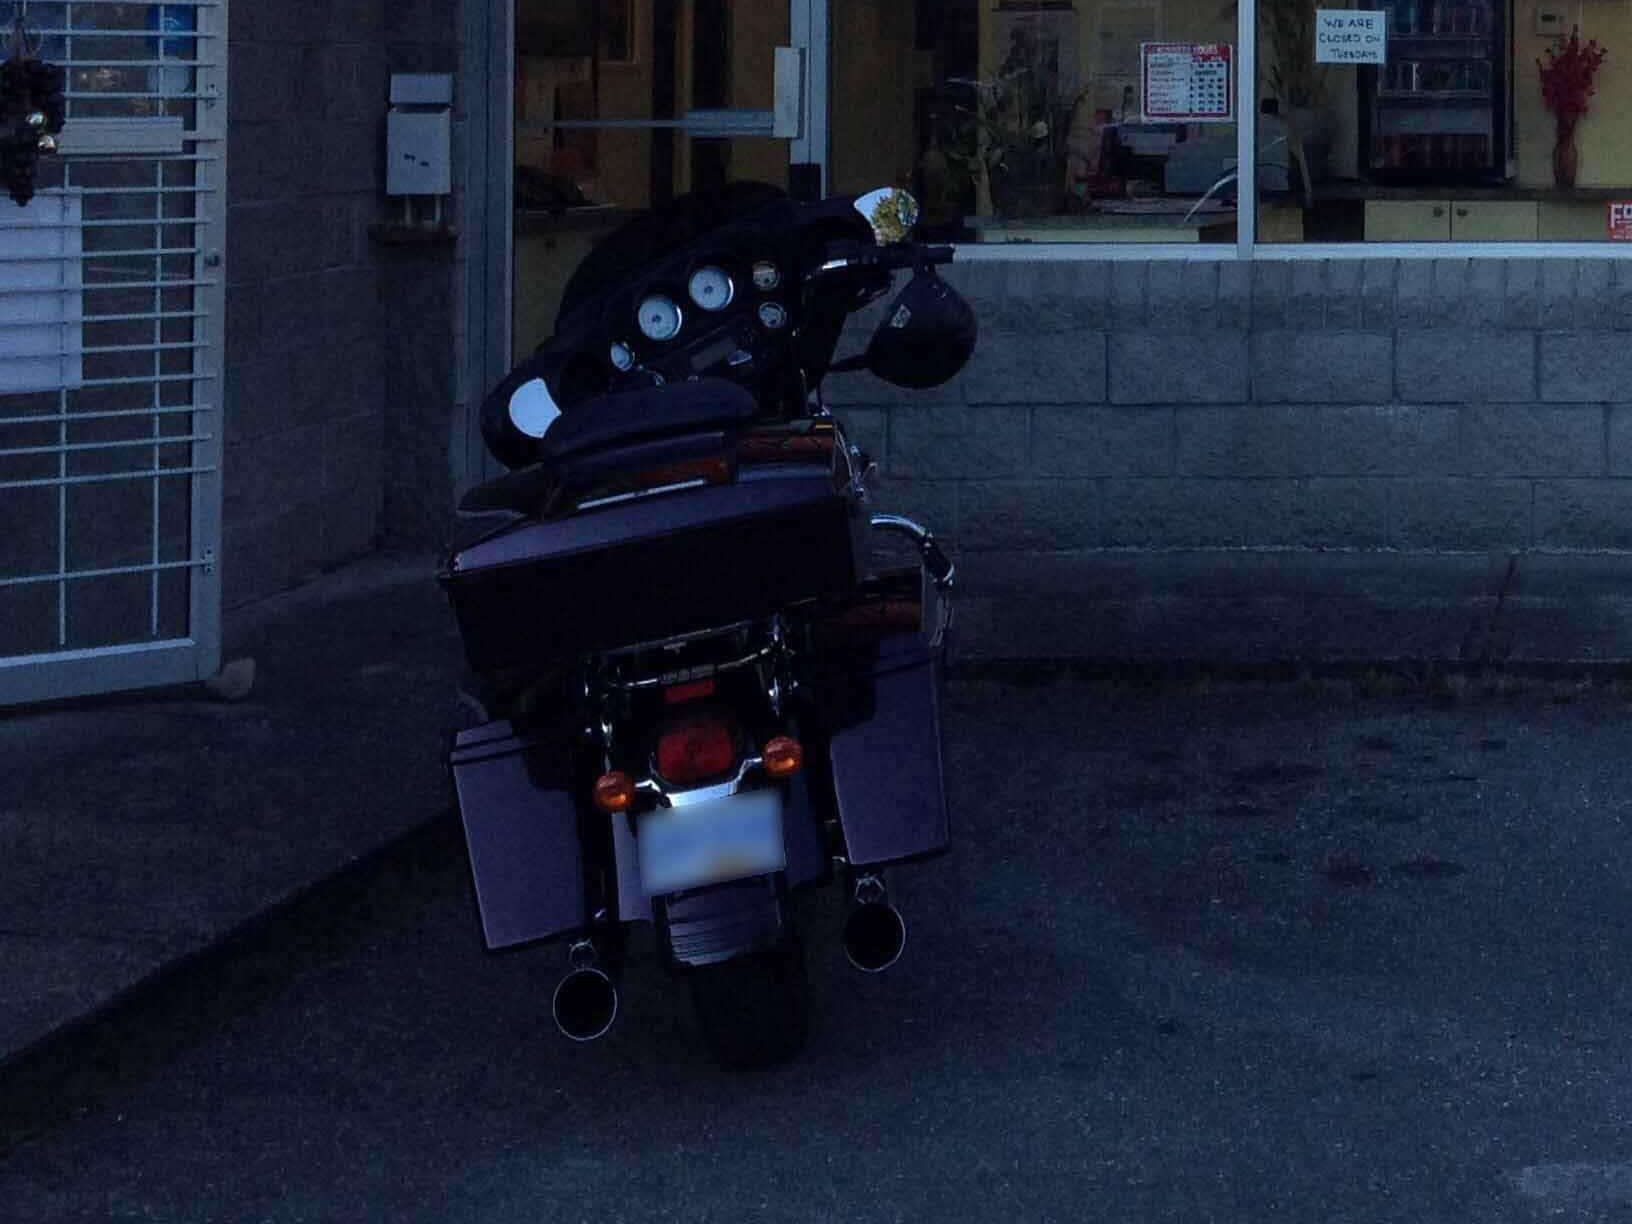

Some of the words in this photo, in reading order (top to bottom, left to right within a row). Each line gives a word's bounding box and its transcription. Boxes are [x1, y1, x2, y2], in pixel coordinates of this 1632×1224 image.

[1323, 18, 1344, 29] WE
[1348, 18, 1374, 30] ARE
[1319, 32, 1361, 44] CLOSED
[1365, 33, 1381, 44] ON
